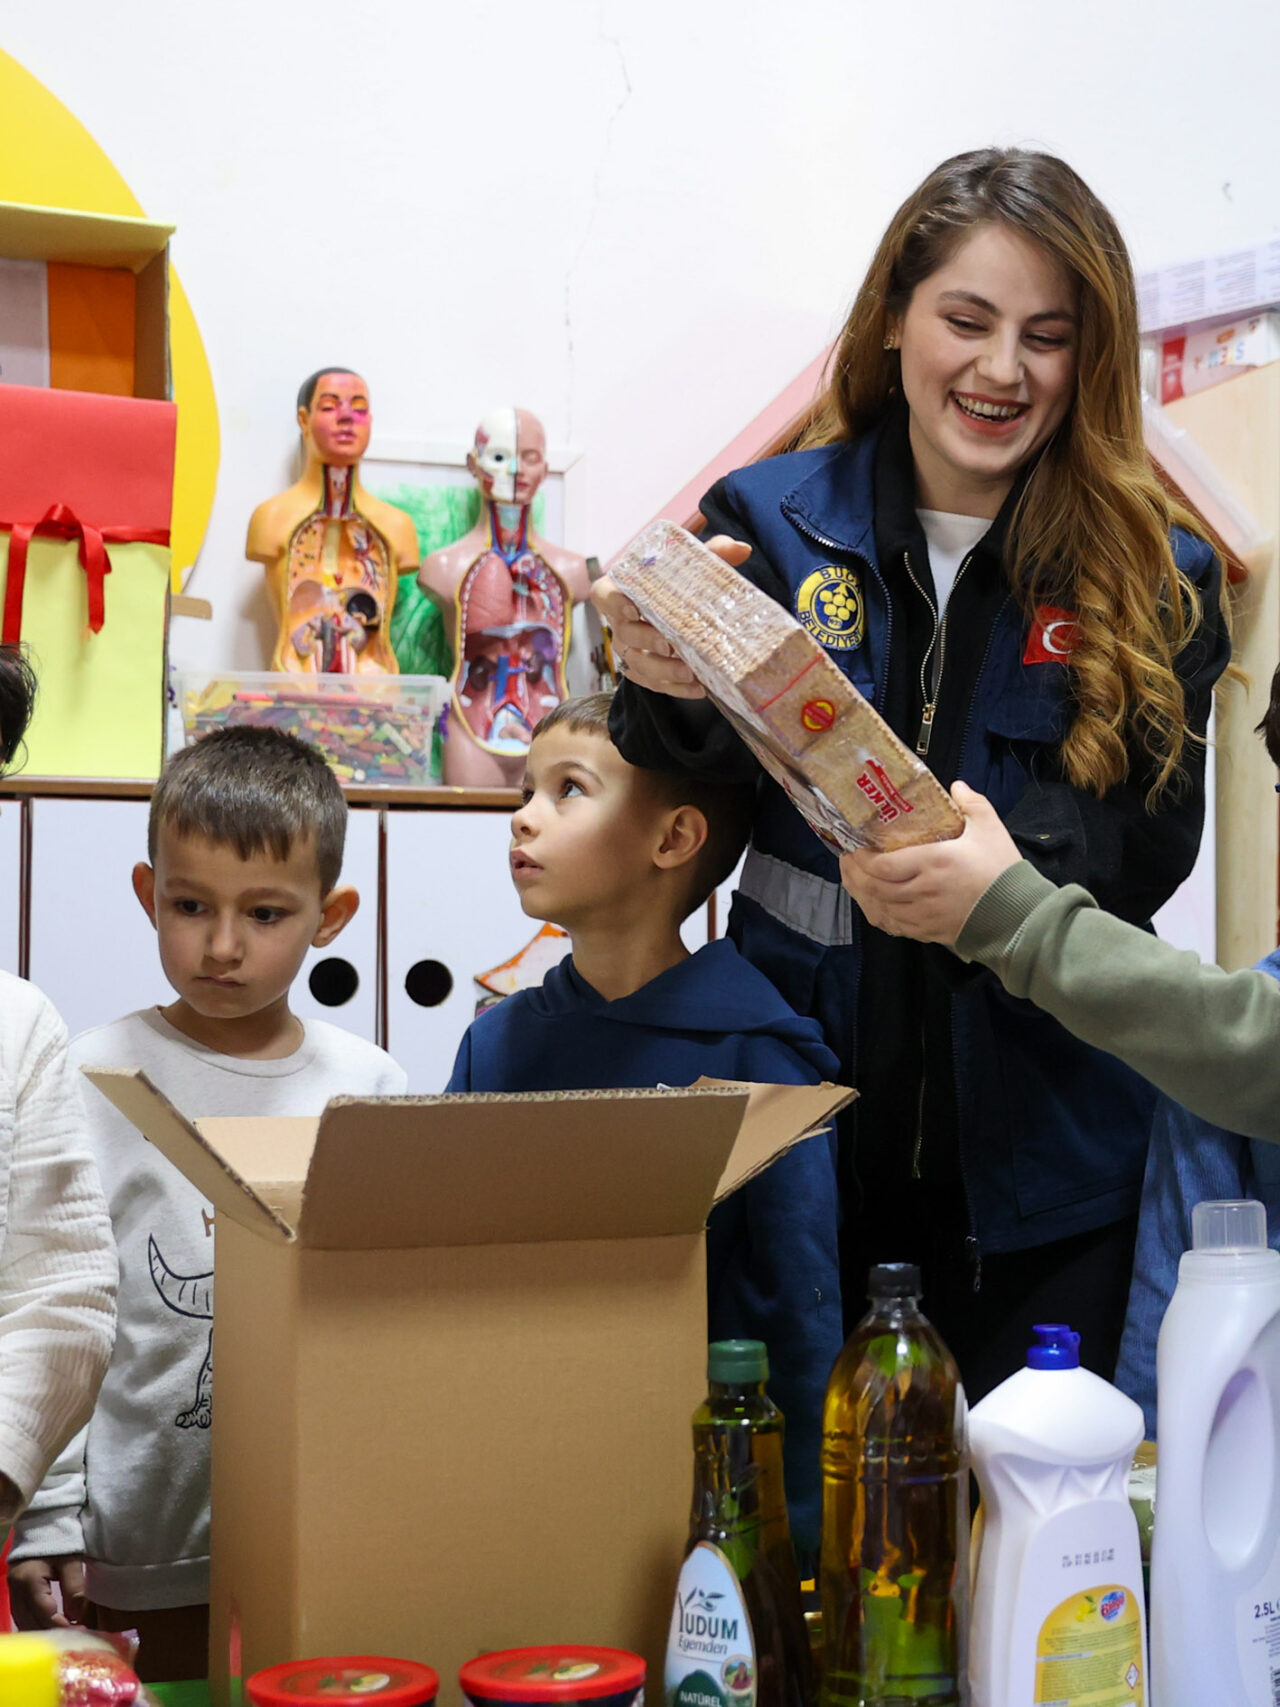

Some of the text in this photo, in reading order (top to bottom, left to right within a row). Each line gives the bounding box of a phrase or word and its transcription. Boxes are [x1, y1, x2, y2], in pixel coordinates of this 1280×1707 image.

[857, 772, 898, 822] ÜLKER
[678, 1592, 738, 1641] YUDUM
[1254, 1602, 1275, 1619] 2.5L
[678, 1636, 728, 1655] Egemden
[680, 1690, 722, 1707] NATÜREL
